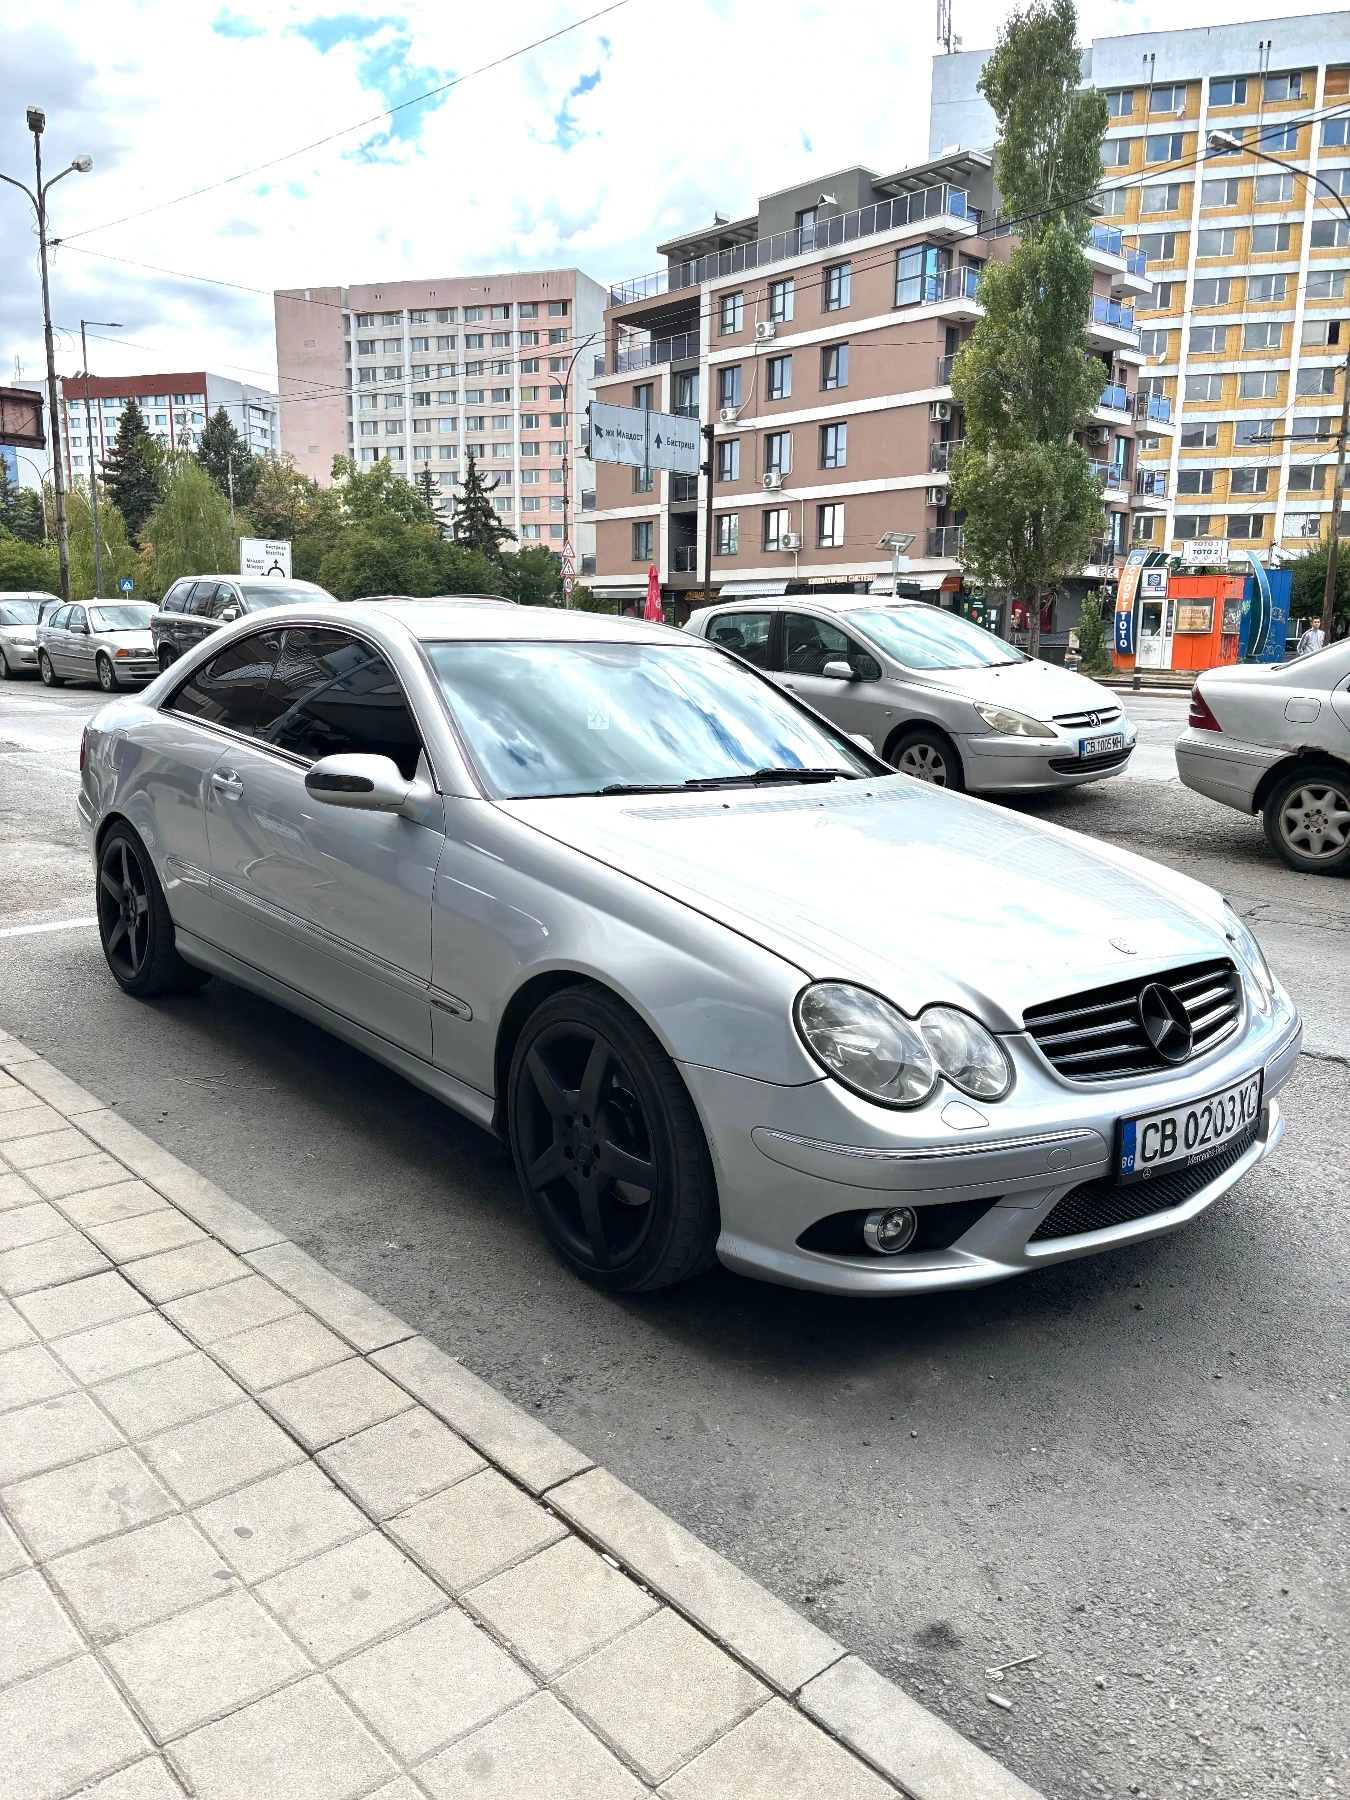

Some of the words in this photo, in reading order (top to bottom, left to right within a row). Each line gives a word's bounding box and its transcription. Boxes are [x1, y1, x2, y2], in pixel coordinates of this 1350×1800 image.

[616, 428, 644, 442] Младост
[666, 437, 695, 450] Бистрица
[1122, 566, 1136, 611] СПОРТ
[1085, 741, 1096, 754] CB
[1140, 1117, 1178, 1163] CB
[1184, 1094, 1236, 1150] 0203
[1121, 1154, 1134, 1169] BG
[1187, 1142, 1228, 1166] Mercedes-Benz
